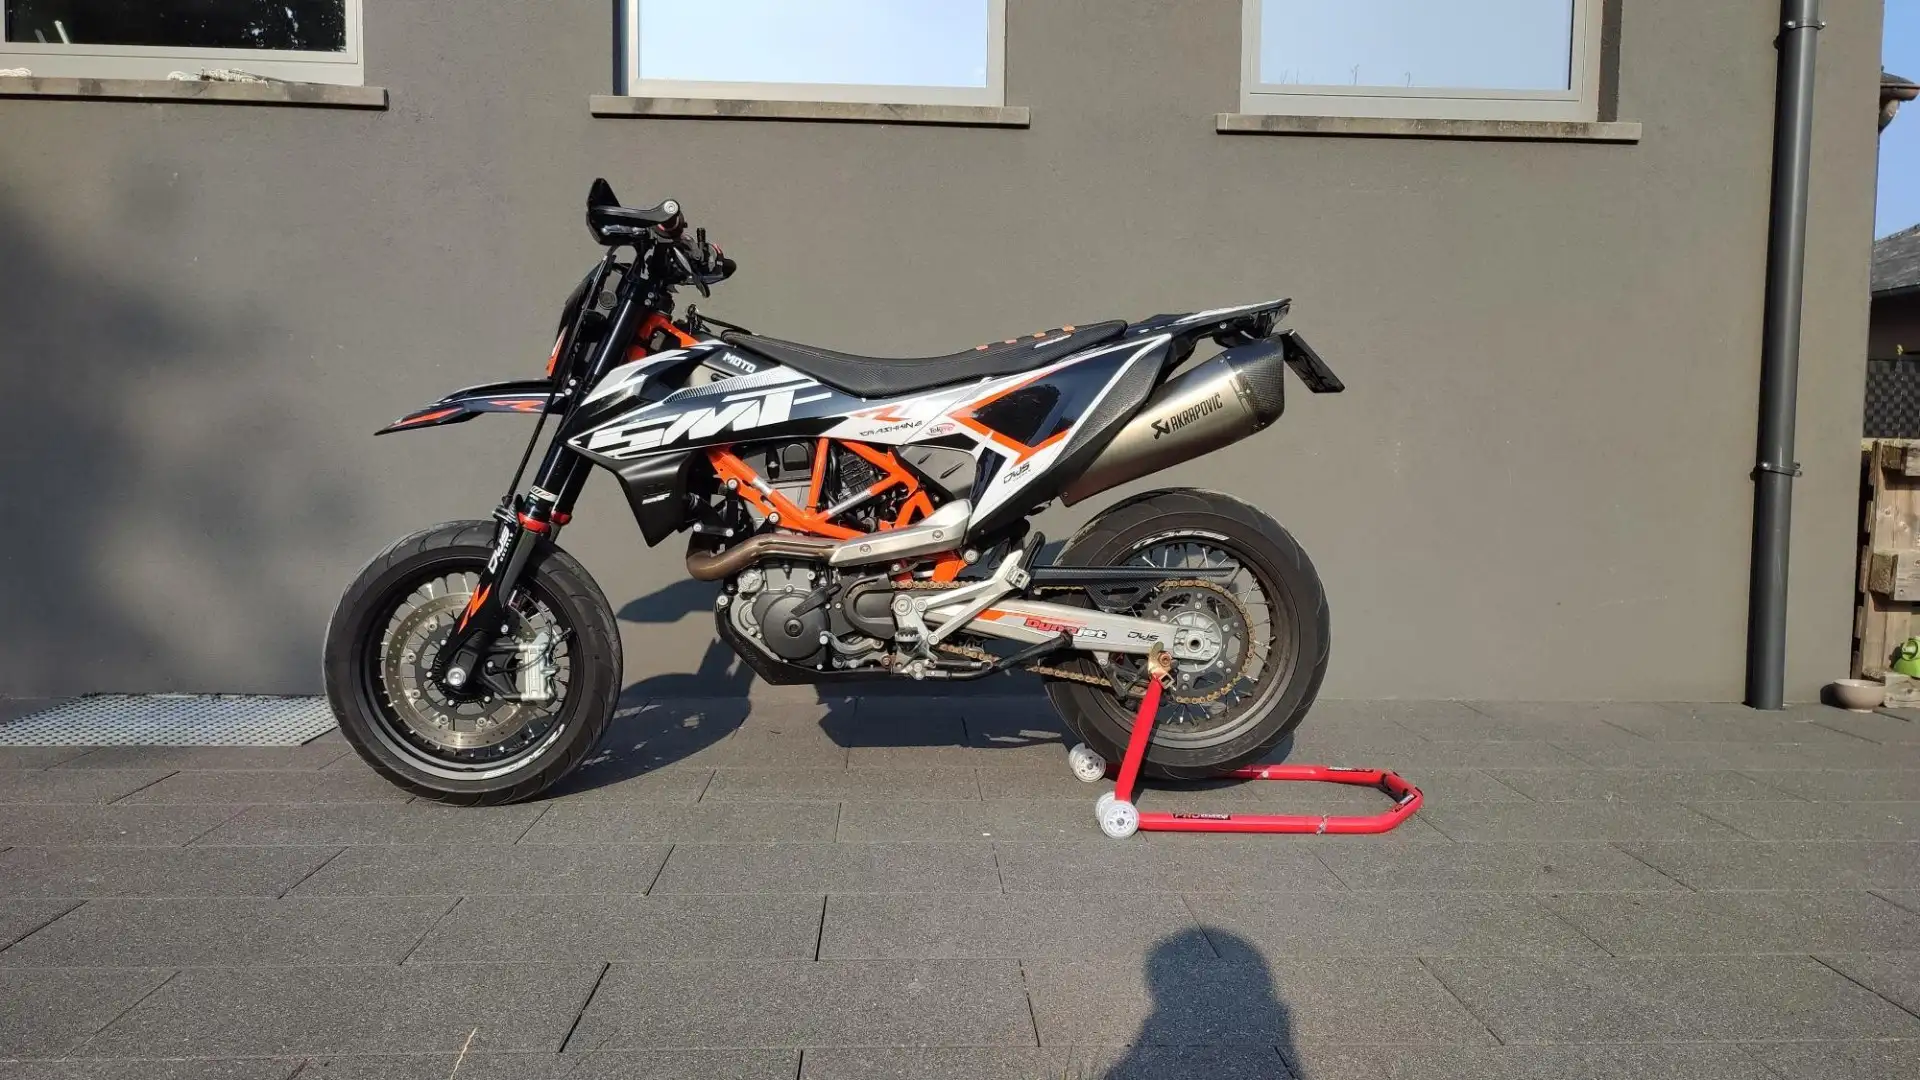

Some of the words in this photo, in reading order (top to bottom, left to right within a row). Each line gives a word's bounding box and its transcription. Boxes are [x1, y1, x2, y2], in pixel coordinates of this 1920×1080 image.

[723, 352, 756, 374] MOTO
[488, 525, 510, 575] DWS
[1023, 617, 1108, 640] Dynajet
